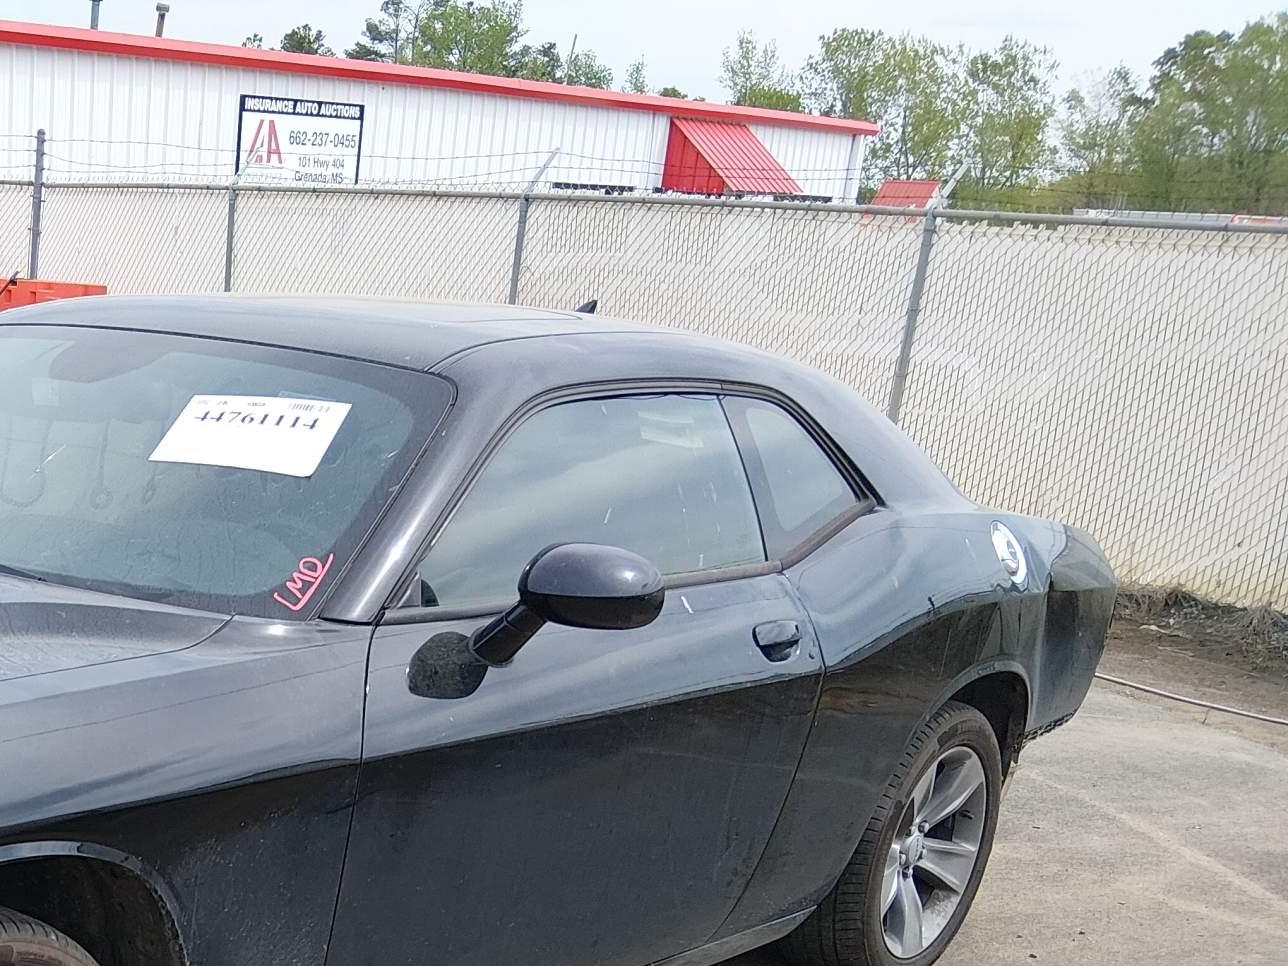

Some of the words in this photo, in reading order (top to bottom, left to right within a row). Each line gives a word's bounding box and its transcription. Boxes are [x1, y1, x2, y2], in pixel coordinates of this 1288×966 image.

[245, 96, 294, 113] INSURANCE
[296, 103, 319, 115] AUTO
[319, 105, 361, 118] AUCTIONS
[289, 130, 357, 149] 662-237-0455
[298, 156, 311, 168] 101
[313, 157, 330, 171] Hwy
[331, 158, 345, 170] 404
[330, 172, 345, 184] MS
[195, 410, 320, 430] 44761114
